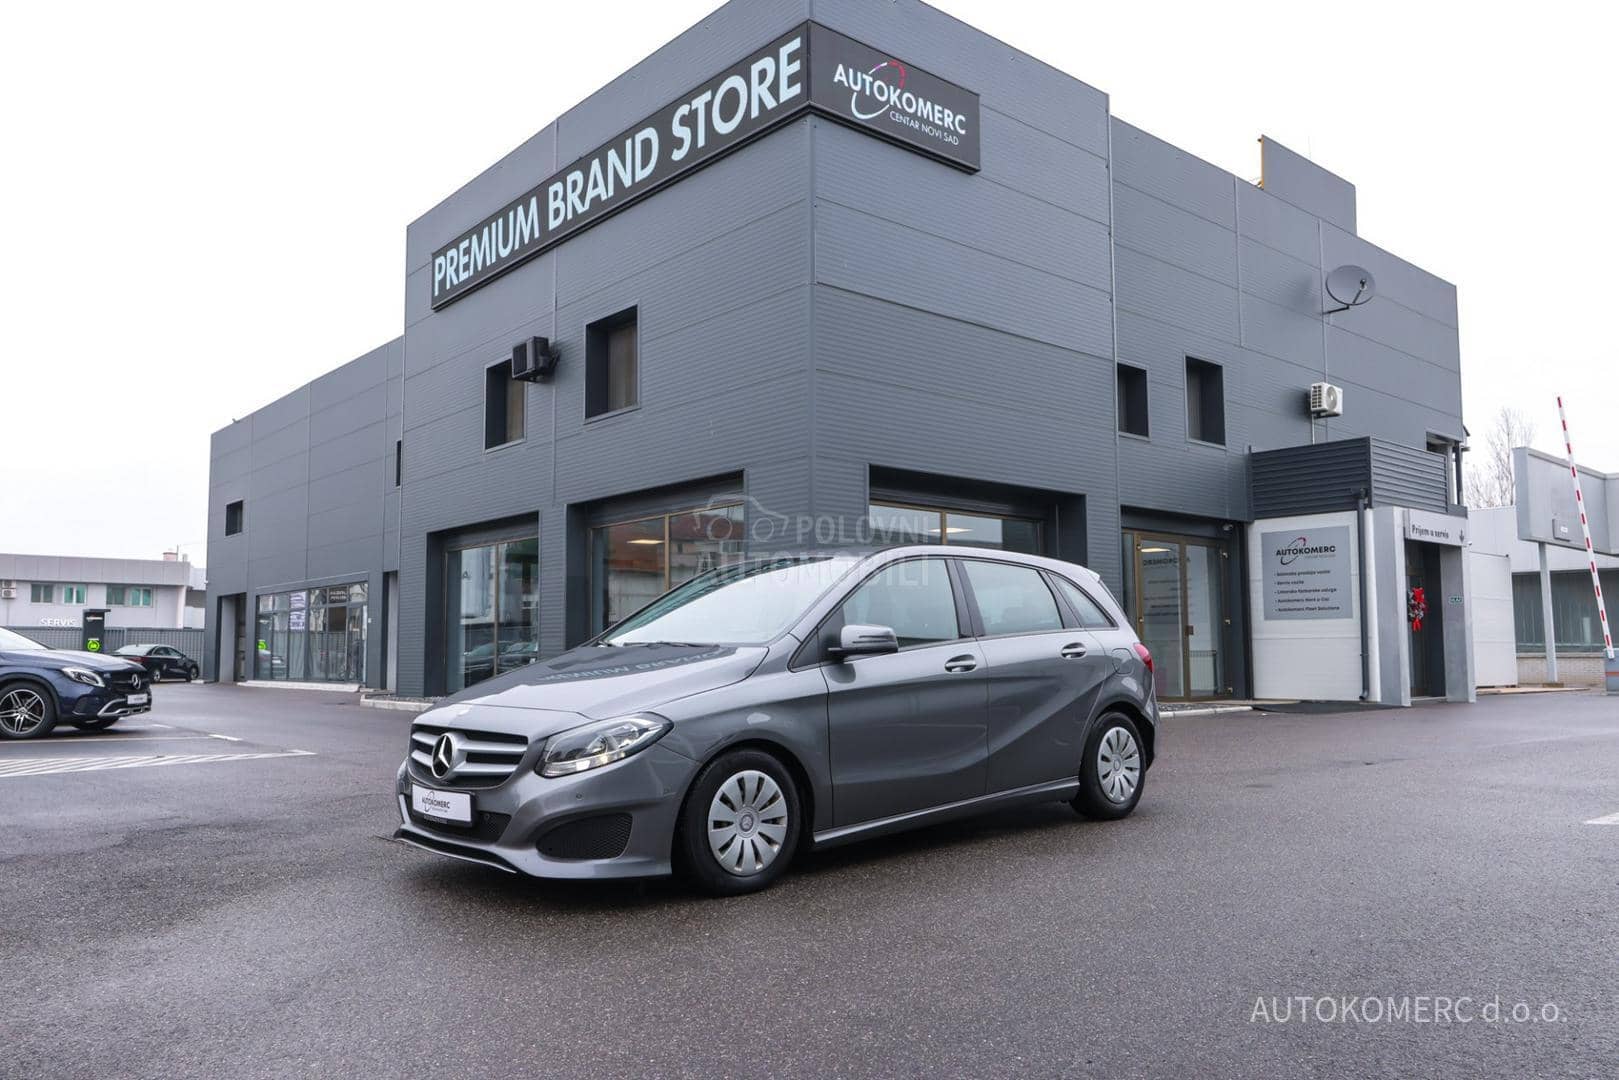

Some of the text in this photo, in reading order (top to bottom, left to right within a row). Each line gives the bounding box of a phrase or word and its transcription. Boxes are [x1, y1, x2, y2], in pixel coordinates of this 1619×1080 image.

[833, 63, 967, 135] AUTOKOMERC
[889, 110, 959, 146] CENTAR NOVI SAD
[434, 36, 802, 296] PREMIUM BRAND STORE
[1276, 545, 1336, 556] AUTOKOMERC
[40, 617, 78, 626] SERVIS
